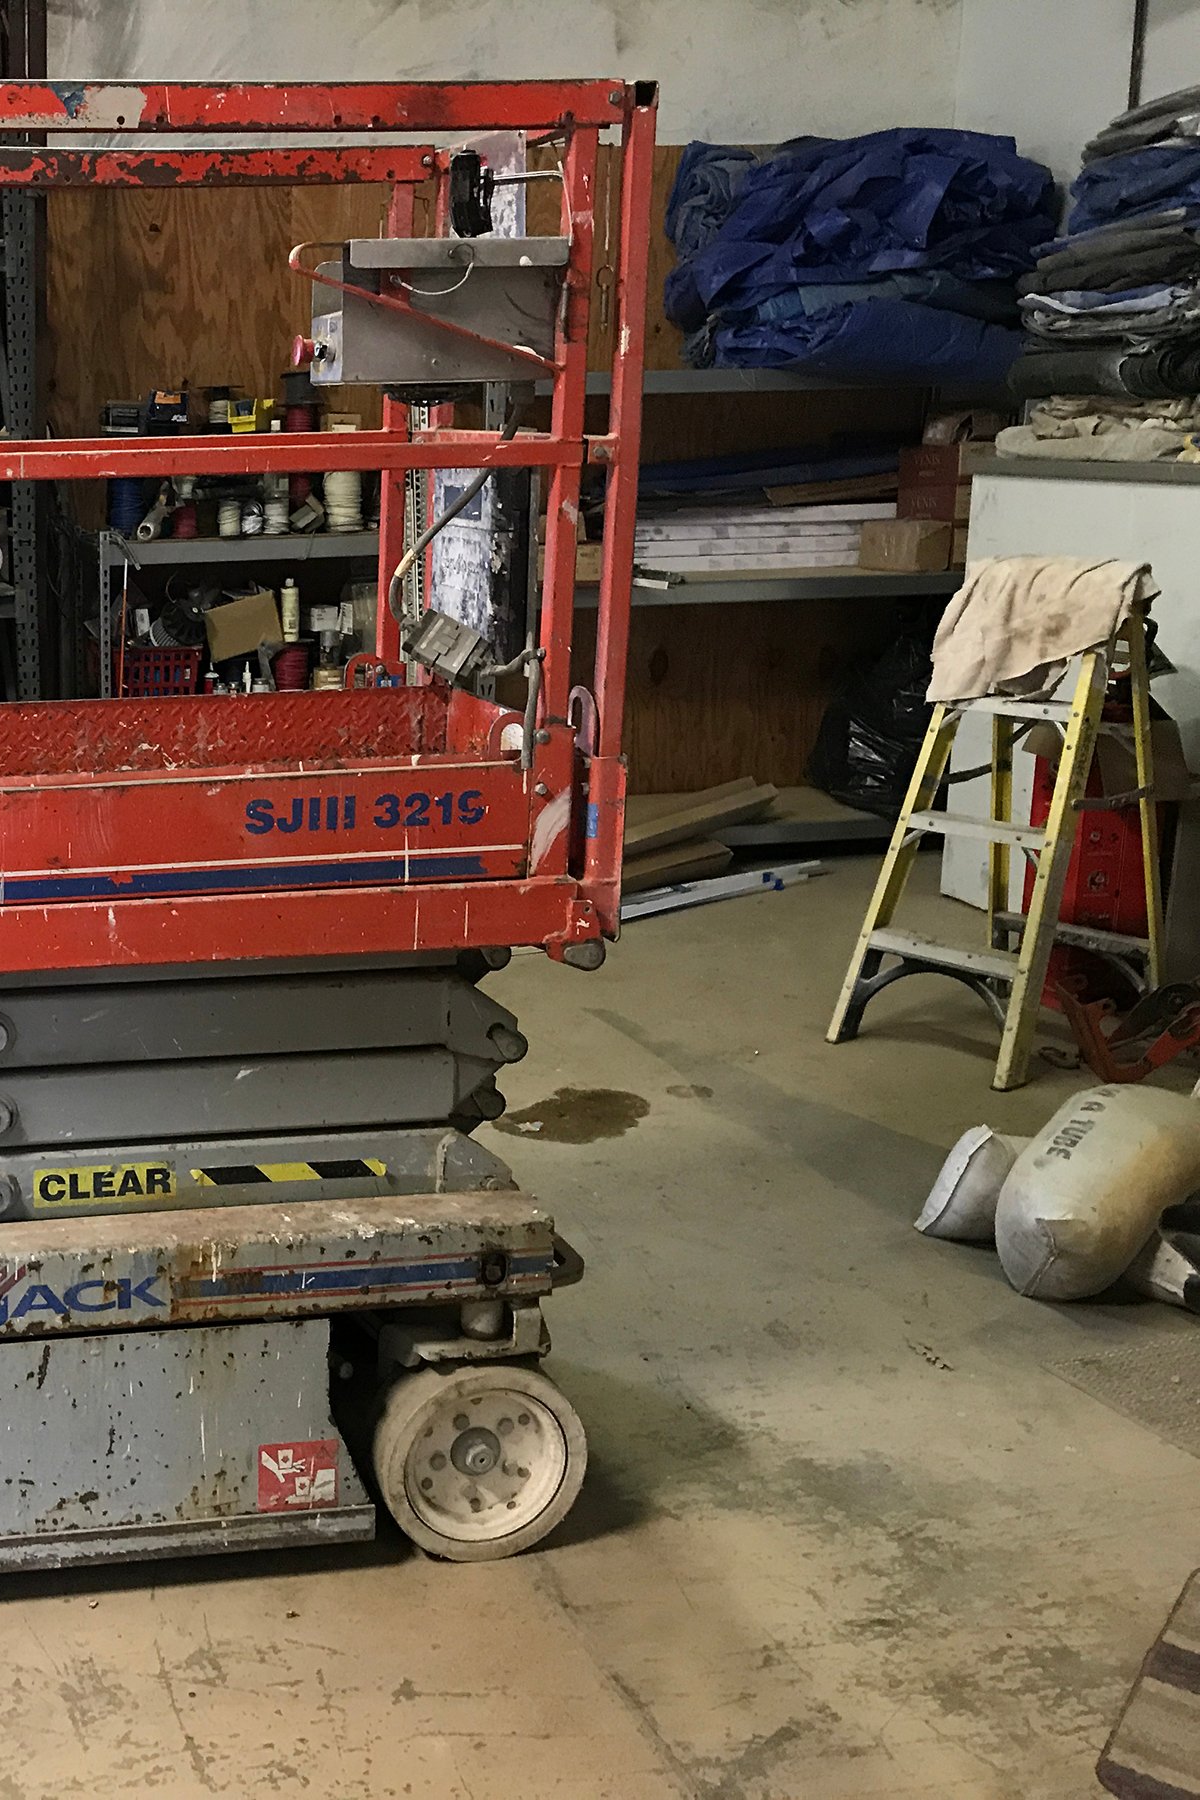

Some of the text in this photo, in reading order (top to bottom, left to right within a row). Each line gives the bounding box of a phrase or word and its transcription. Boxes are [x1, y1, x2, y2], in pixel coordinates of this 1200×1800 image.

[245, 790, 485, 835] SJIII 3219
[1046, 1119, 1096, 1160] TUBE
[38, 1167, 172, 1202] CLEAR
